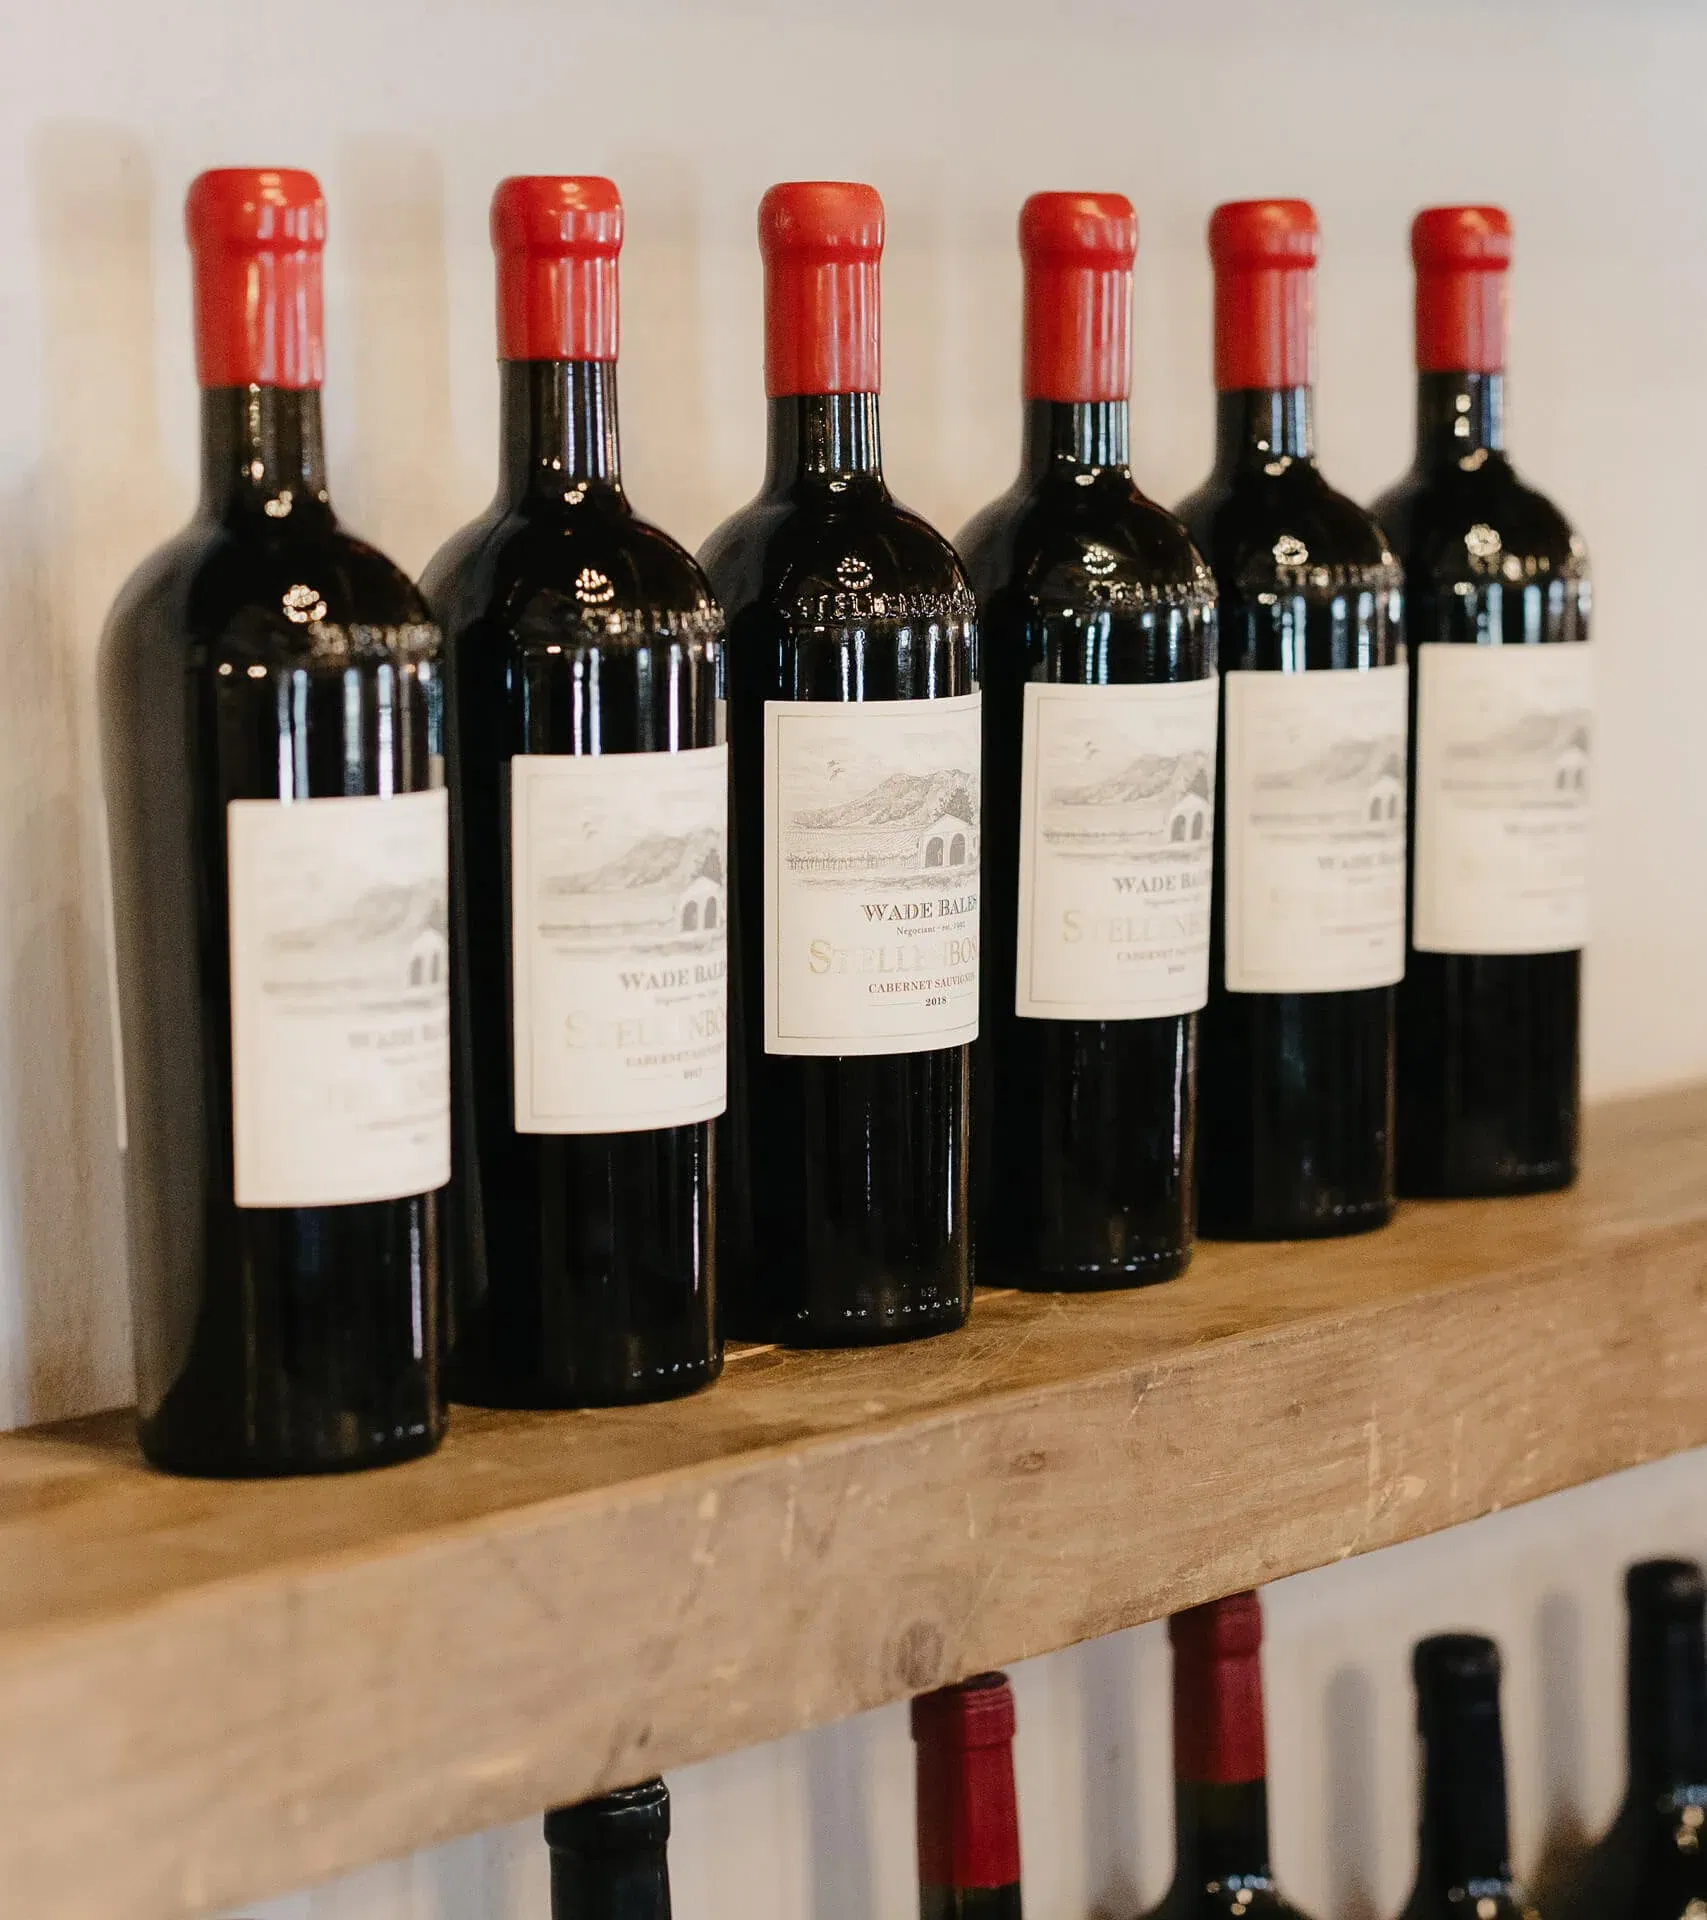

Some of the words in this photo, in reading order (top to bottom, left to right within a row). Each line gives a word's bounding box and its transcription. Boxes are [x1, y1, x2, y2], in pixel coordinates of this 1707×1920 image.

[1112, 874, 1177, 895] WADE
[860, 902, 933, 922] WADE
[618, 968, 690, 992] WADE
[868, 979, 933, 993] CABERNET
[925, 996, 947, 1007] 2018
